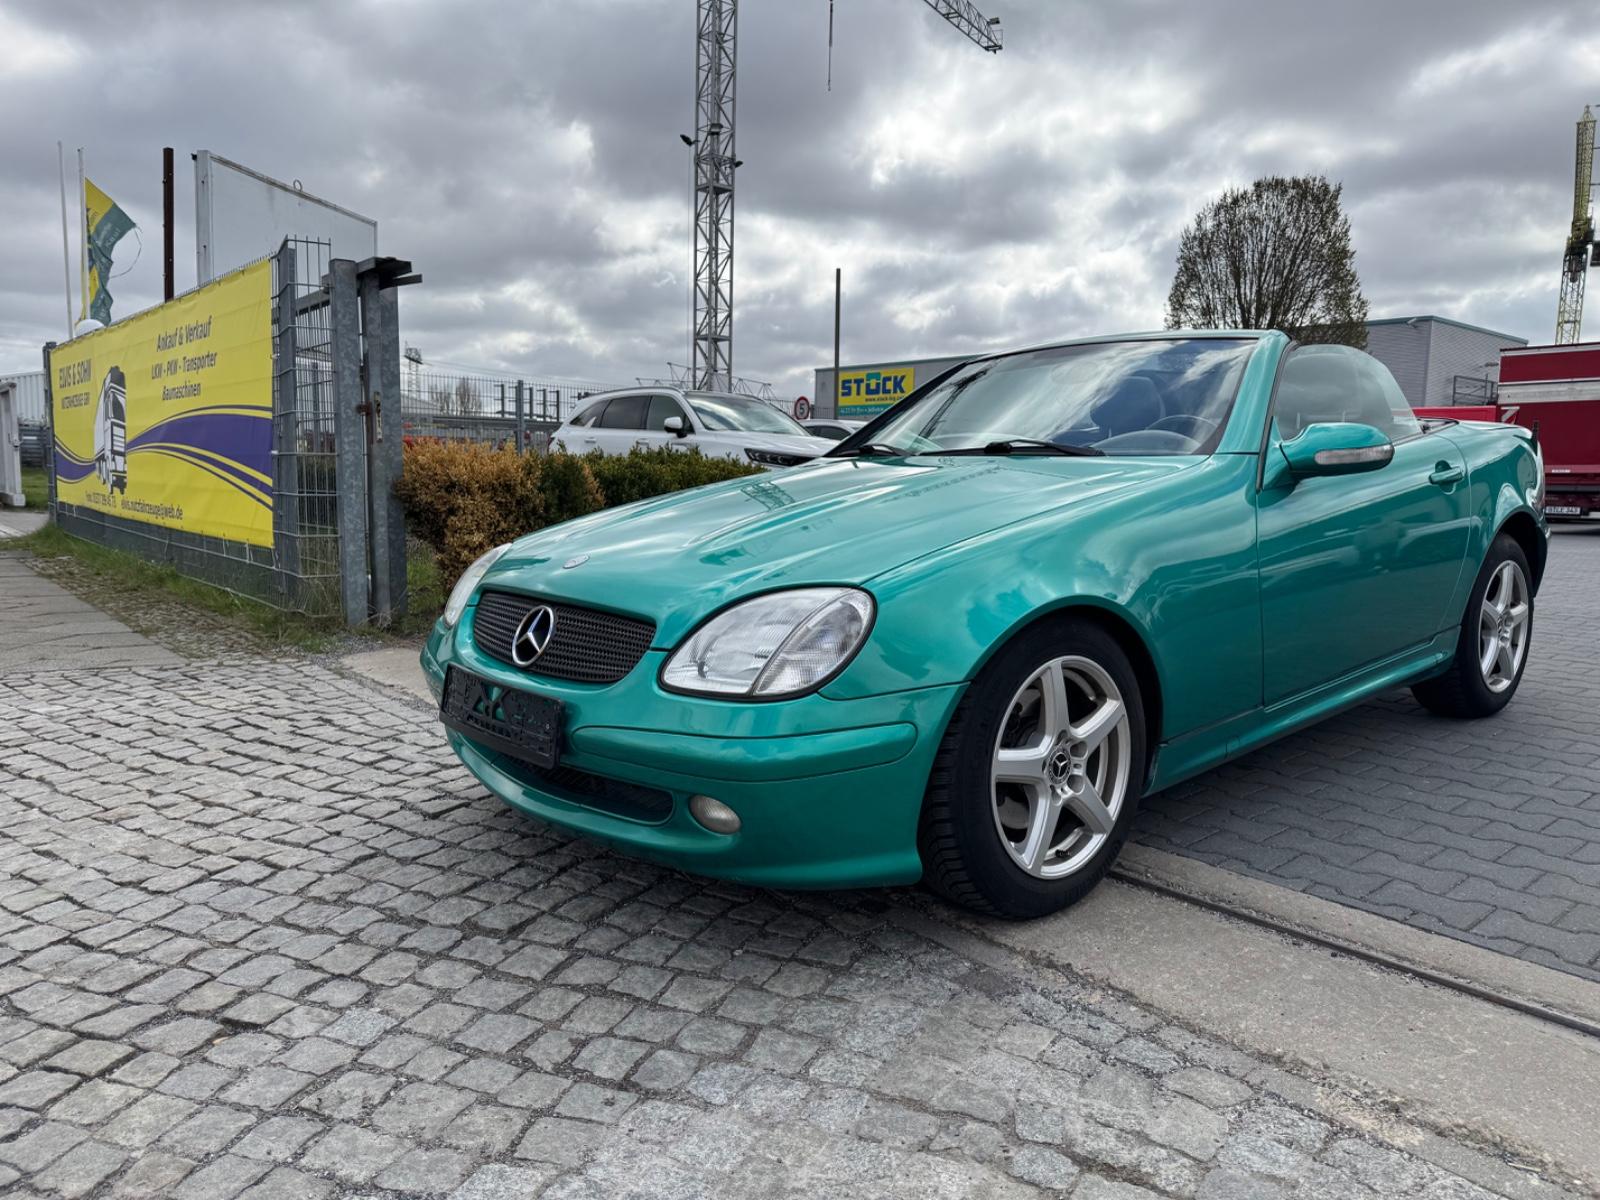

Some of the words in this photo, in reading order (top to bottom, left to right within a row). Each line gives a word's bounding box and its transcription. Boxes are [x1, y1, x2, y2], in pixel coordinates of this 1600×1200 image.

[157, 328, 178, 352] Ankauf
[185, 315, 212, 344] Verkauf
[183, 351, 217, 375] Transporter
[162, 380, 201, 401] Baumaschinen
[800, 403, 806, 414] 5
